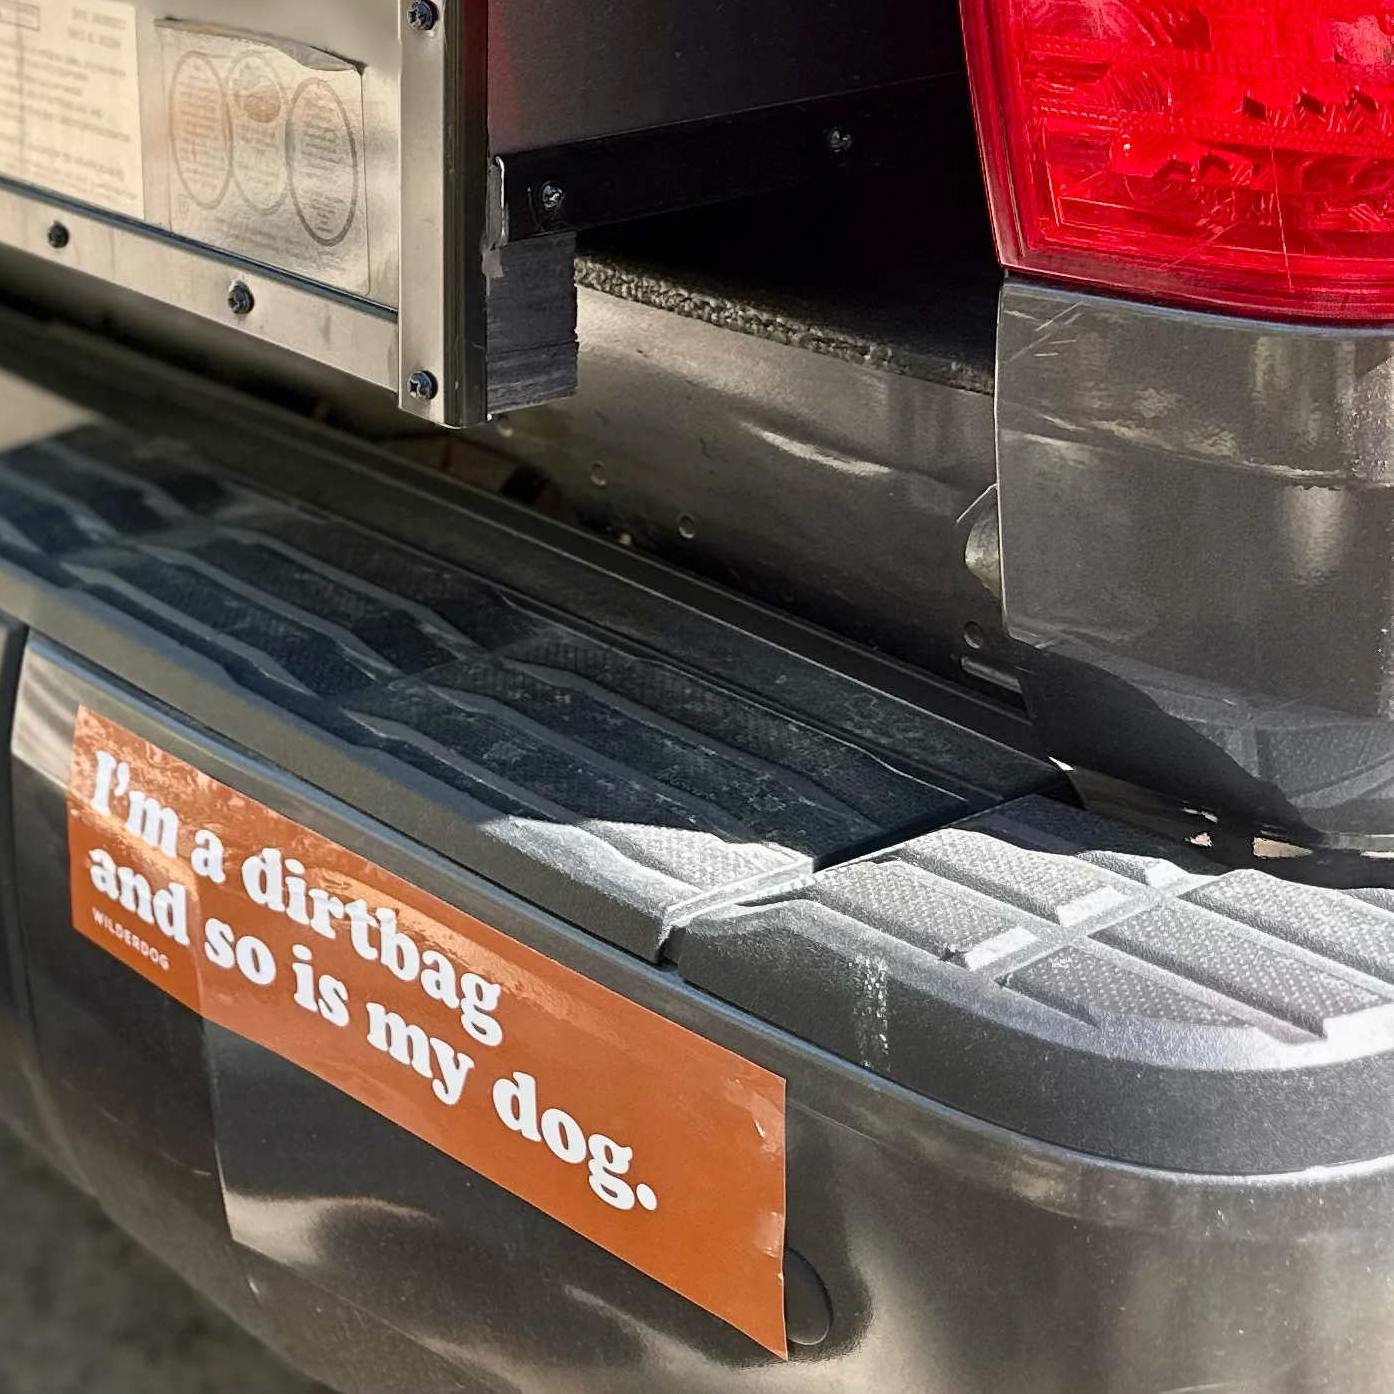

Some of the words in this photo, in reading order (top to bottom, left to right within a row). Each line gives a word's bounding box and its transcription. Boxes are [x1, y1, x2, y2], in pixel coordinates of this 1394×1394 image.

[88, 848, 191, 946] and
[204, 918, 276, 985] so
[292, 944, 350, 1027] is
[365, 1002, 475, 1105] my
[492, 1071, 657, 1211] dog.
[89, 749, 180, 860] I'm
[190, 829, 226, 884] a
[241, 847, 503, 1047] dirtbag
[92, 907, 171, 971] WILDERDOG
